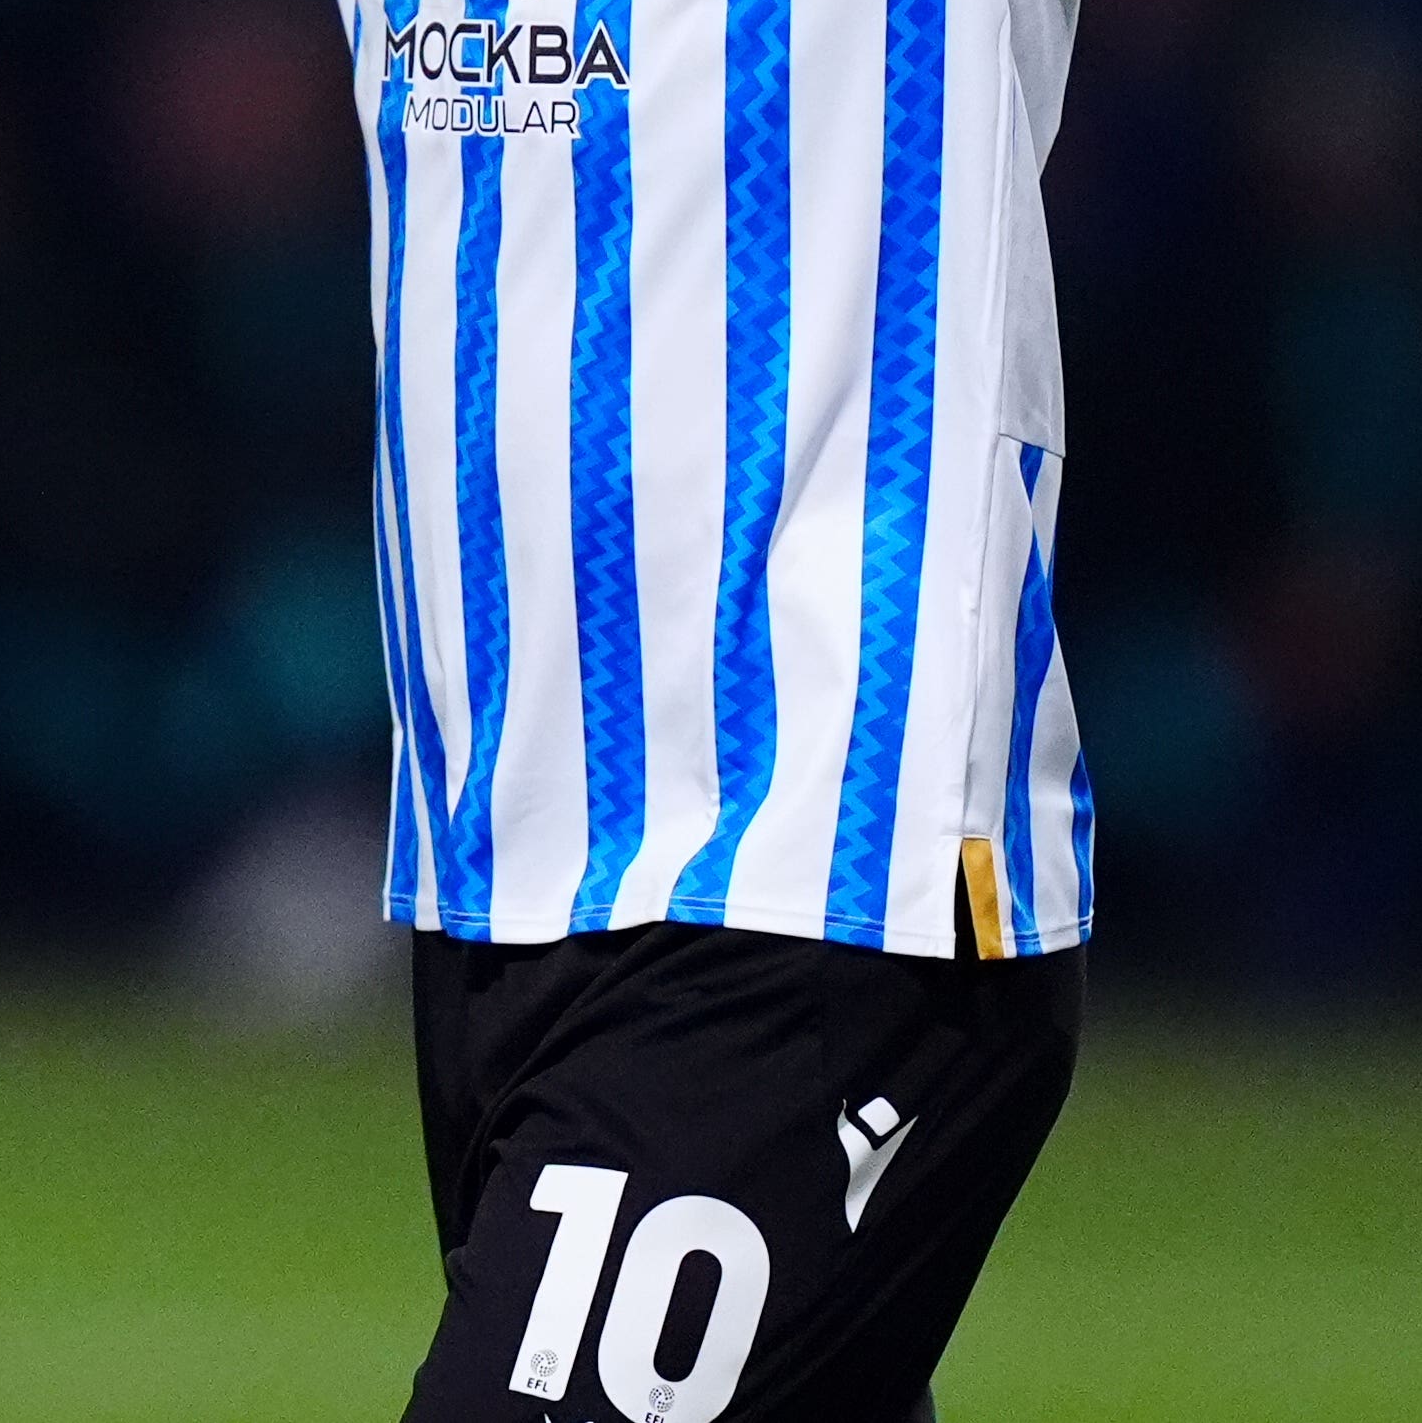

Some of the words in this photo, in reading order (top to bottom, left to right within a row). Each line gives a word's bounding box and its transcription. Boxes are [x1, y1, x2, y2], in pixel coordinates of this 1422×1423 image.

[383, 21, 628, 86] MOCKBA
[405, 97, 576, 135] MODULAR
[508, 1163, 771, 1423] 10
[526, 1377, 548, 1393] EFL
